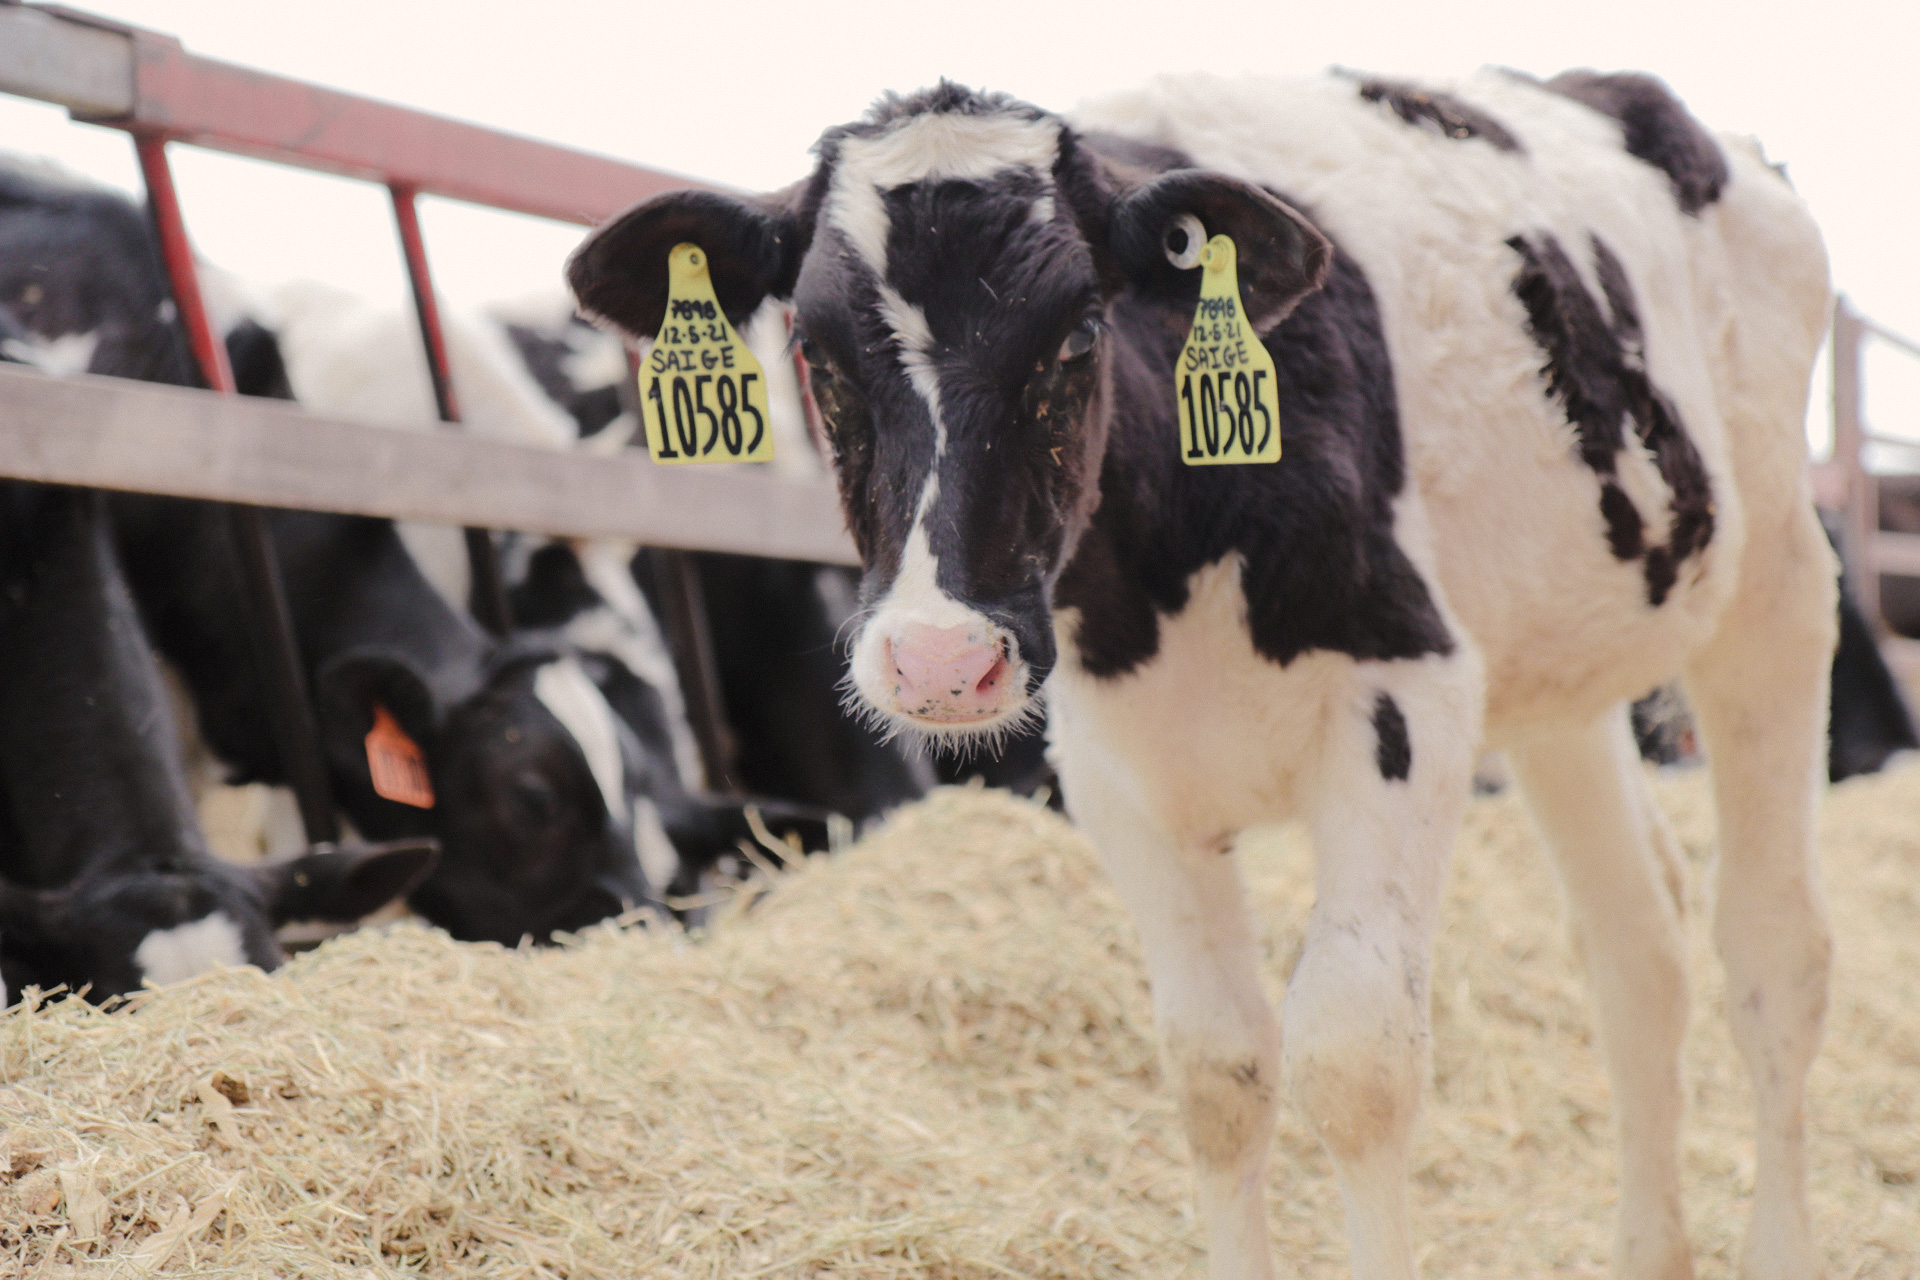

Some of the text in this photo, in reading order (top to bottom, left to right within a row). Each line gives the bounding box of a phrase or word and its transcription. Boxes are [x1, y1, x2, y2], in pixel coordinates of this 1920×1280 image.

[651, 346, 735, 373] SAIGE
[1185, 341, 1249, 372] SAIGE
[648, 373, 764, 458] 10585
[1182, 370, 1271, 458] 10585
